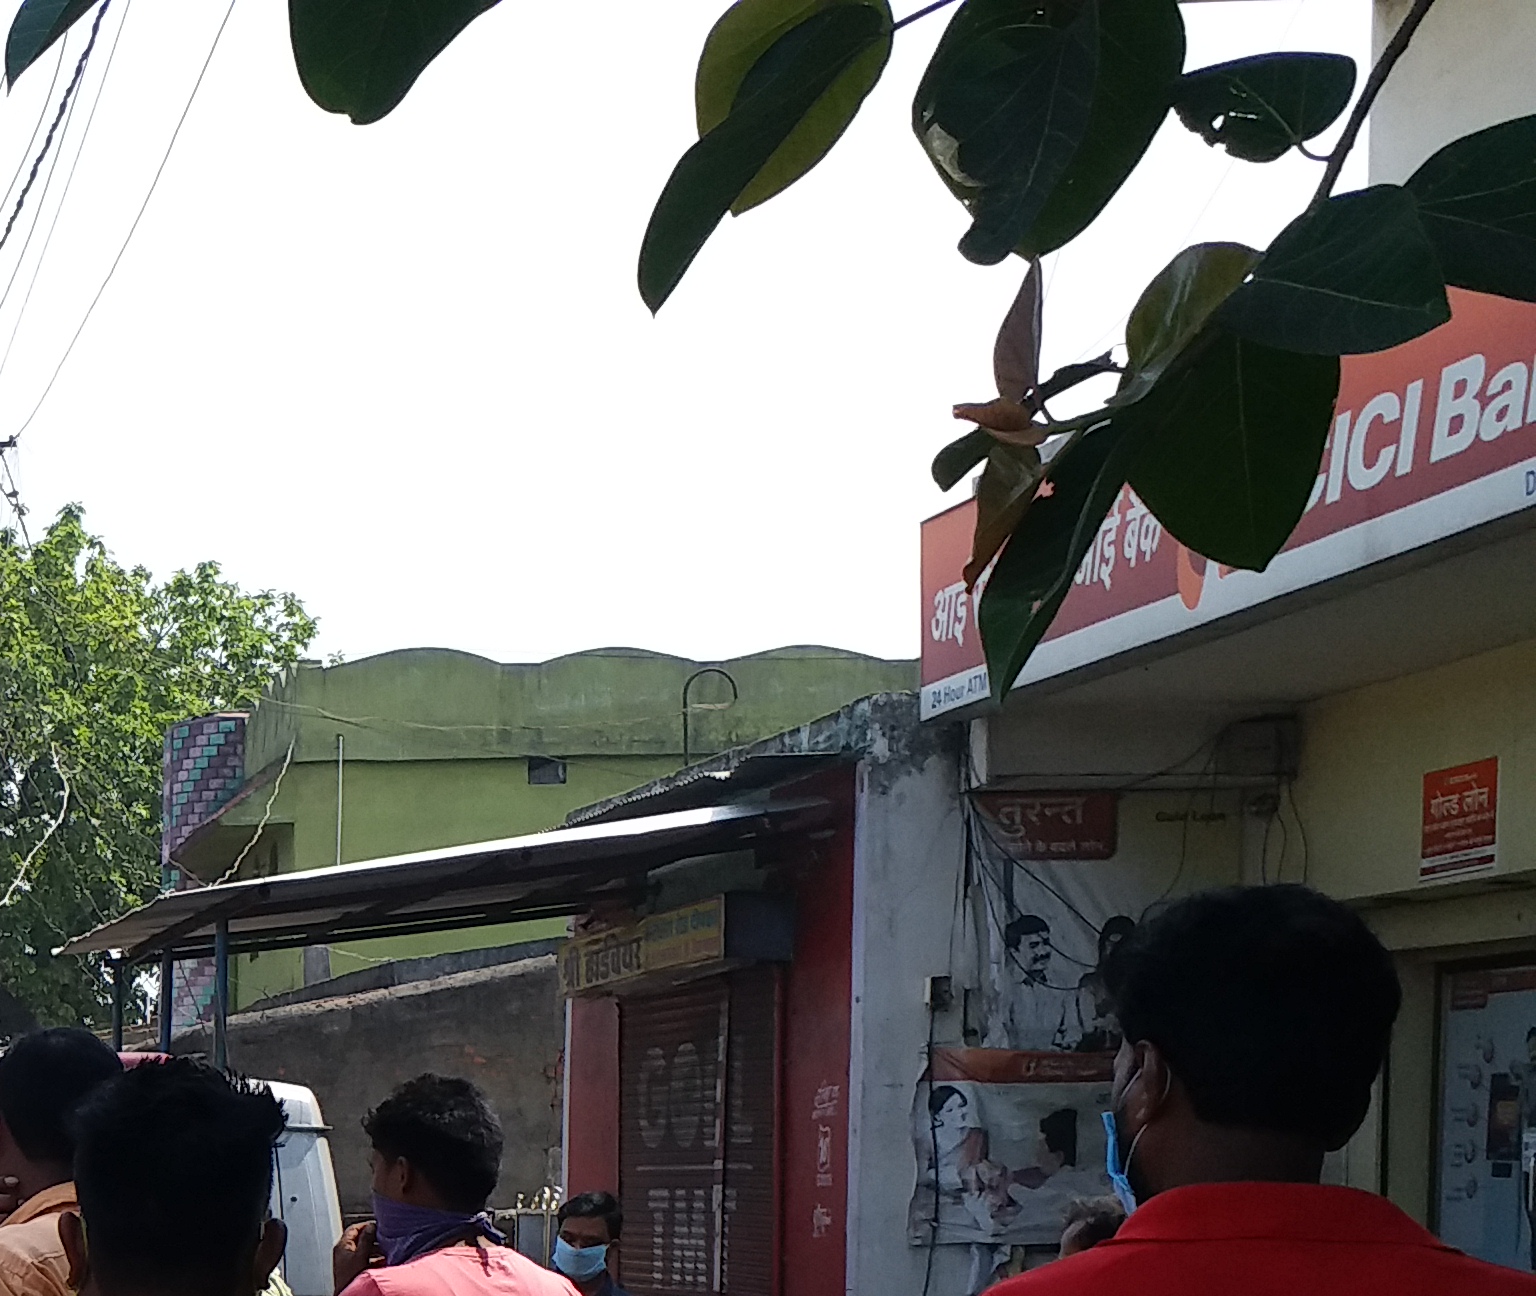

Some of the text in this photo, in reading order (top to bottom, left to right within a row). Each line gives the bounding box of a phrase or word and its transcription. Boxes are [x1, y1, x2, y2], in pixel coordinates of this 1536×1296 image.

[931, 672, 987, 708] 24 Hour ATM
[1462, 780, 1490, 813] लोन
